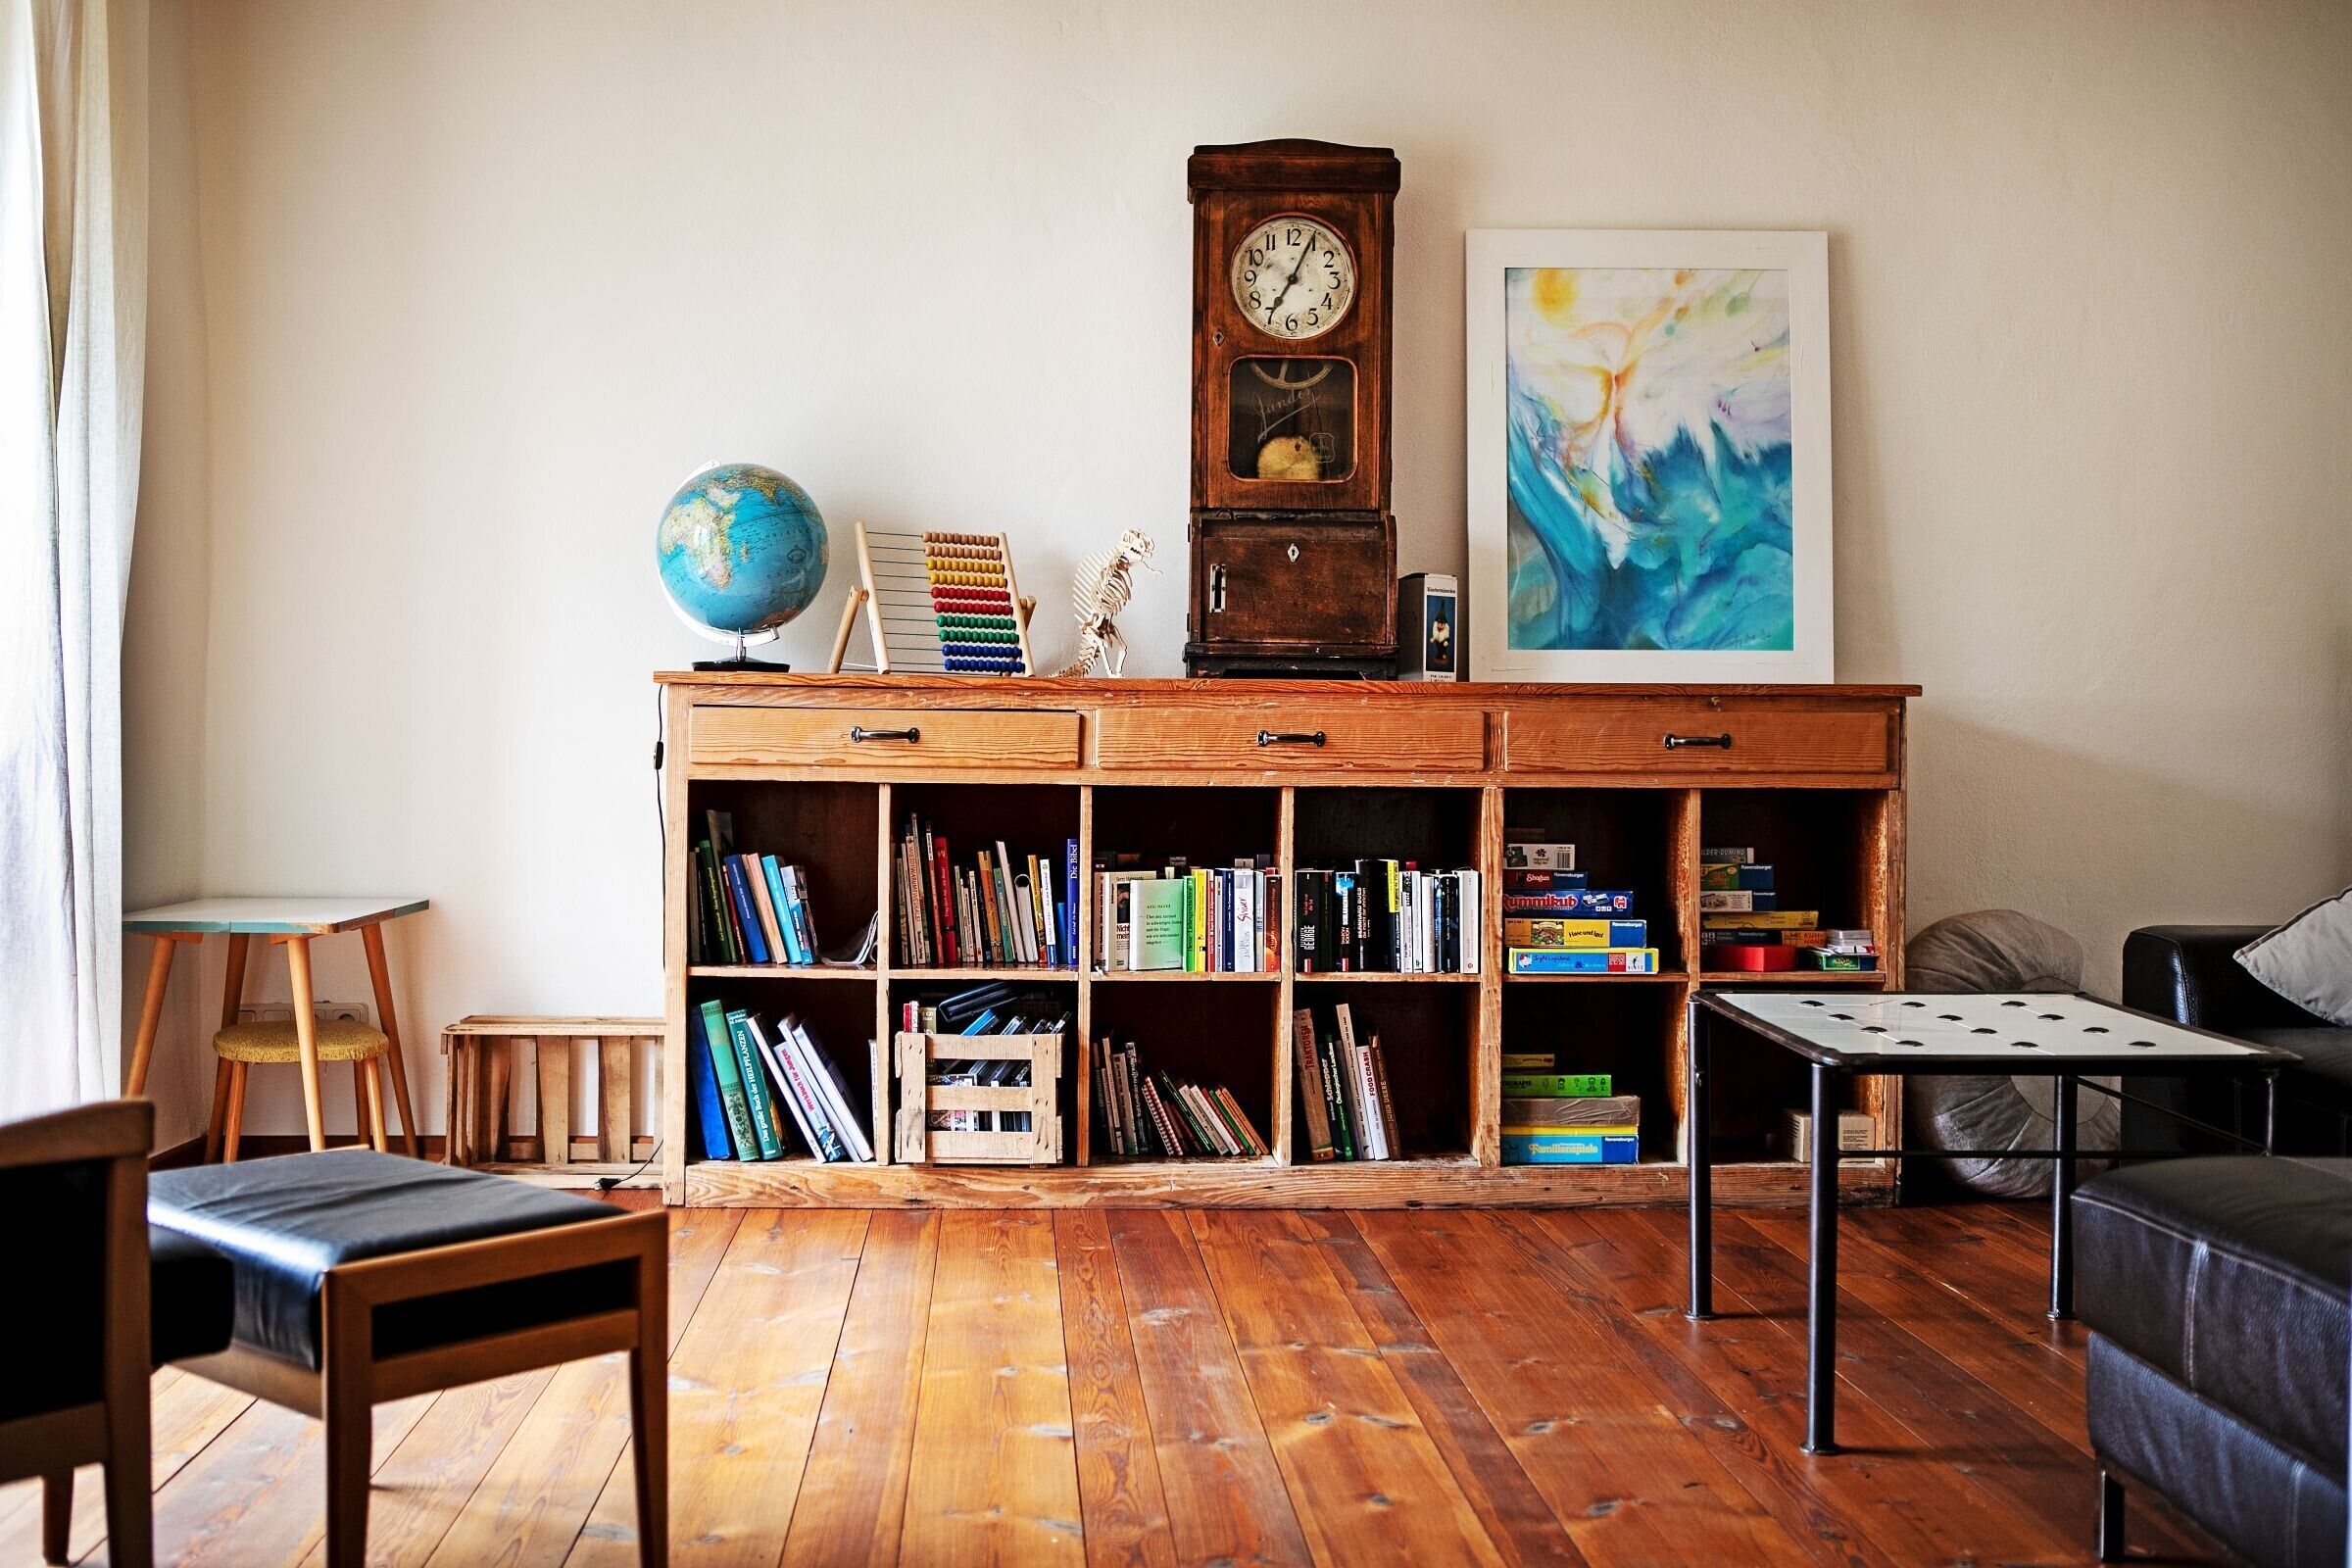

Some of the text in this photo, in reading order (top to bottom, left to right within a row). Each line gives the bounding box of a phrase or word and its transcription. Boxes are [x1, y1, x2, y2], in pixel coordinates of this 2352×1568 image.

[1265, 233, 1276, 251] 11
[1286, 228, 1302, 246] 12
[1311, 233, 1316, 251] 1
[1249, 248, 1264, 267] 10
[1323, 251, 1335, 269] 2
[1244, 270, 1257, 288] 9
[1328, 271, 1341, 290] 3
[1249, 291, 1262, 309] 8
[1320, 292, 1333, 311] 4
[1265, 307, 1276, 324] 7
[1285, 313, 1298, 331] 6
[1307, 308, 1319, 325] 5
[1303, 924, 1314, 950] GEORGE
[1300, 1024, 1315, 1069] TRAKTOREN
[1328, 1042, 1343, 1104] Ökologischer Landbau
[1362, 1052, 1373, 1078] CRASH
[737, 1030, 770, 1143] Das große Buch der HEILPFLANZEN
[780, 1048, 815, 1111] Werkbuch für Jungen
[1321, 1057, 1334, 1102] Schlepper
[1367, 1076, 1376, 1097] FOOD
[1380, 1080, 1391, 1103] DEERE
